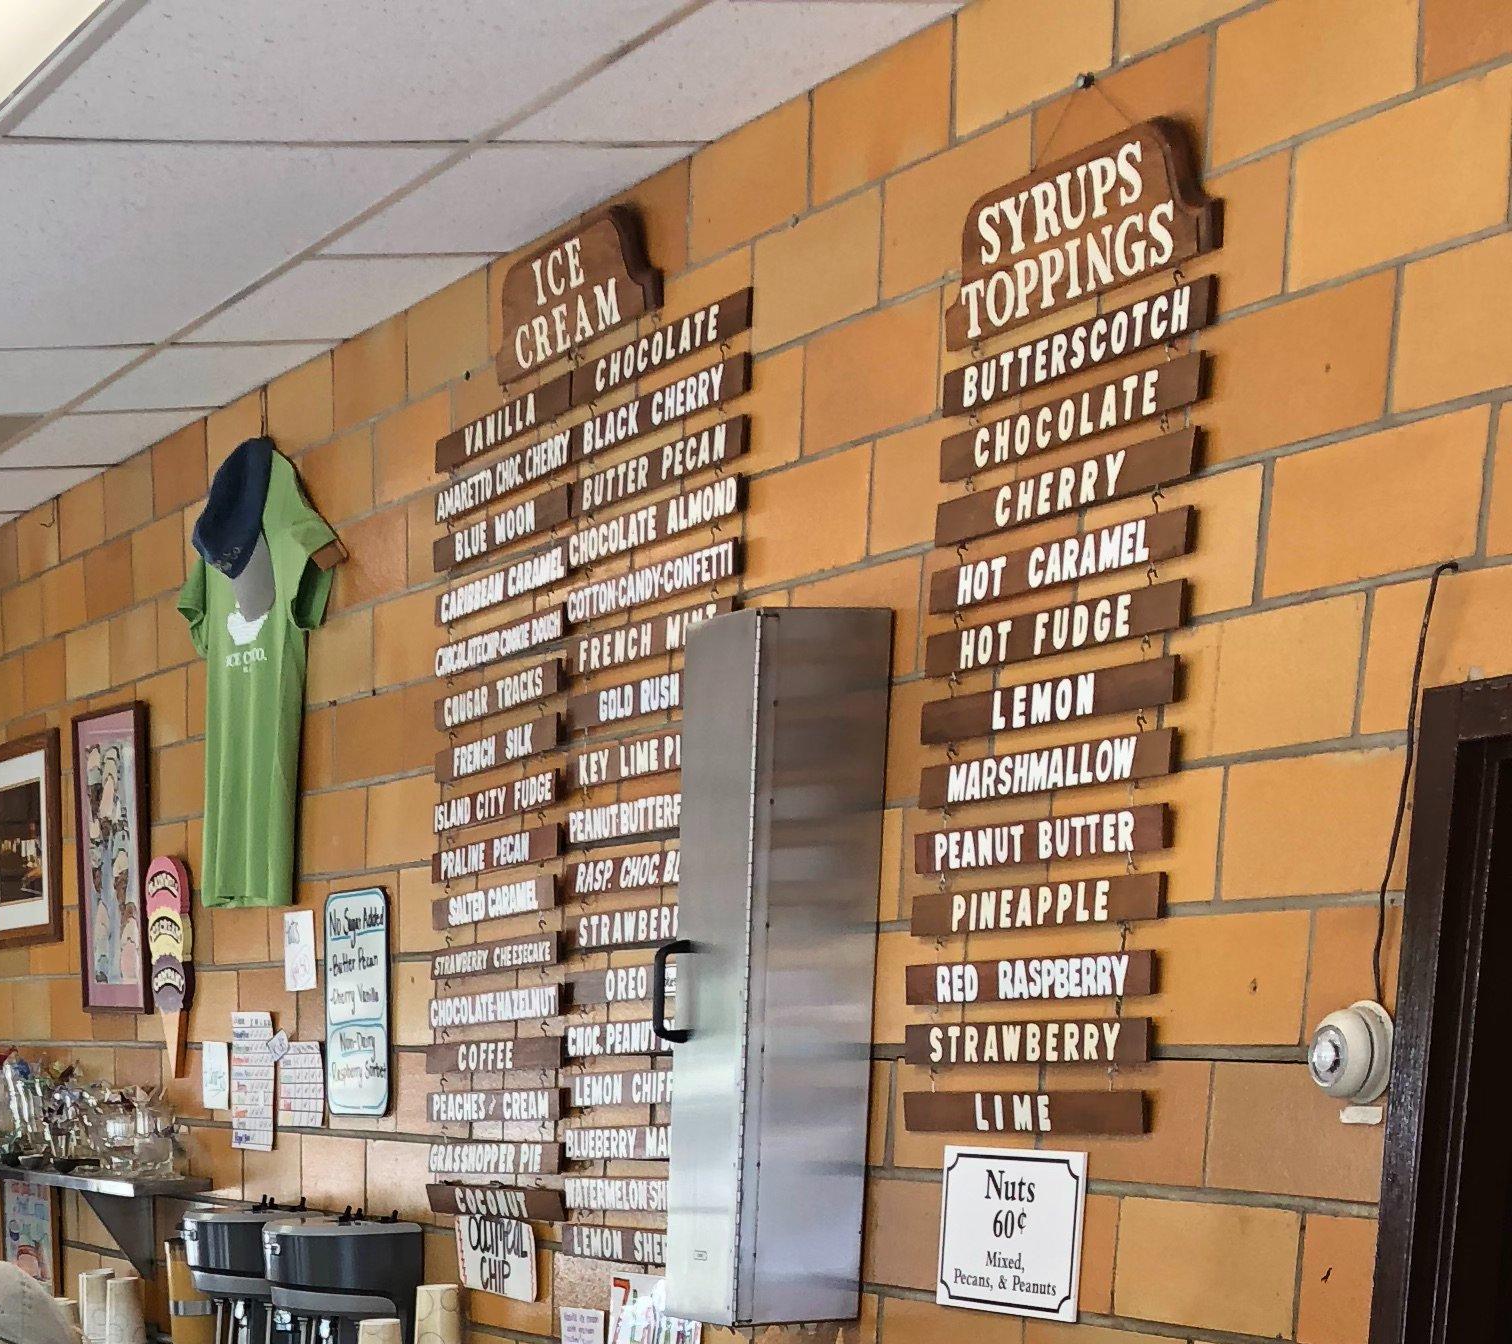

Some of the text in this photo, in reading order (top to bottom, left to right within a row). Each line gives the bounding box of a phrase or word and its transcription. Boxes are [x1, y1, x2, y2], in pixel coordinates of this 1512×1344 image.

[977, 141, 1143, 265] SYRUPS
[532, 237, 586, 306] ICE
[961, 200, 1175, 339] TOPPINGS
[514, 278, 621, 371] CREAM
[594, 304, 720, 392] CHOCOLATE
[962, 286, 1191, 409] BUTTERSCOTCH
[464, 393, 536, 456] VANILLA
[582, 364, 725, 455] BLACK CHERRY
[973, 370, 1159, 468] CHOCOLATE
[437, 469, 492, 522] AMARETTO
[526, 430, 570, 481] CHERRY
[582, 425, 726, 510] BUTTER PECAN
[994, 449, 1127, 528] CHERRY
[455, 500, 535, 561] BLUE MOON
[568, 477, 736, 567] CHOCOLATE ALMOND
[440, 547, 565, 623] CARIBBEAN CARAMEL
[957, 519, 1150, 606] HOT CARAMEL
[579, 622, 651, 672] FRENCH
[959, 594, 1132, 669] HOT FUDGE
[444, 667, 543, 727] COUGAR TRACKS
[599, 672, 680, 722] GOLD RUSH
[991, 672, 1095, 731] LEMON
[454, 723, 533, 777] FRENCH SILK
[579, 735, 680, 785] KEY LIME PI
[947, 737, 1138, 803] MARSHMALLOW
[434, 772, 552, 832] ISLAND CITY FUDGE
[441, 832, 529, 880] PRALINE PECAN
[934, 810, 1134, 871] PEANUT BUTTER
[575, 850, 680, 893] RASP. CHOC. BL
[330, 910, 341, 936] No
[448, 880, 538, 926] SALTED CARAMEL
[579, 906, 678, 947] STRAWBER
[951, 880, 1110, 932] PINEAPPLE
[434, 941, 551, 976] STRAWBERRY CHEESECAKE
[606, 967, 647, 1000] OREO
[936, 955, 1128, 1003] RED RASPBERRY
[458, 1041, 513, 1071] COFFEE
[568, 1025, 603, 1056] CHOC.
[606, 1021, 656, 1054] PEANUT
[930, 1023, 1121, 1063] STRAWBERRY
[432, 1093, 486, 1120] PEACHES
[503, 1090, 549, 1120] CREAM
[575, 1071, 673, 1106] LEMON CHIFF
[975, 1095, 1052, 1130] LIME
[430, 1143, 542, 1173] GRASSHOPPER PIE
[566, 1126, 672, 1158] BLUEBERRY MA
[455, 1187, 528, 1218] COCONUT
[984, 1169, 1036, 1203] Nuts
[573, 1226, 667, 1263] LEMON SHE
[992, 1209, 1027, 1241] 60¢
[480, 1256, 511, 1294] CHIP
[954, 1269, 1057, 1298] Pecans, & Peanuts
[985, 1250, 1025, 1274] Mixed,
